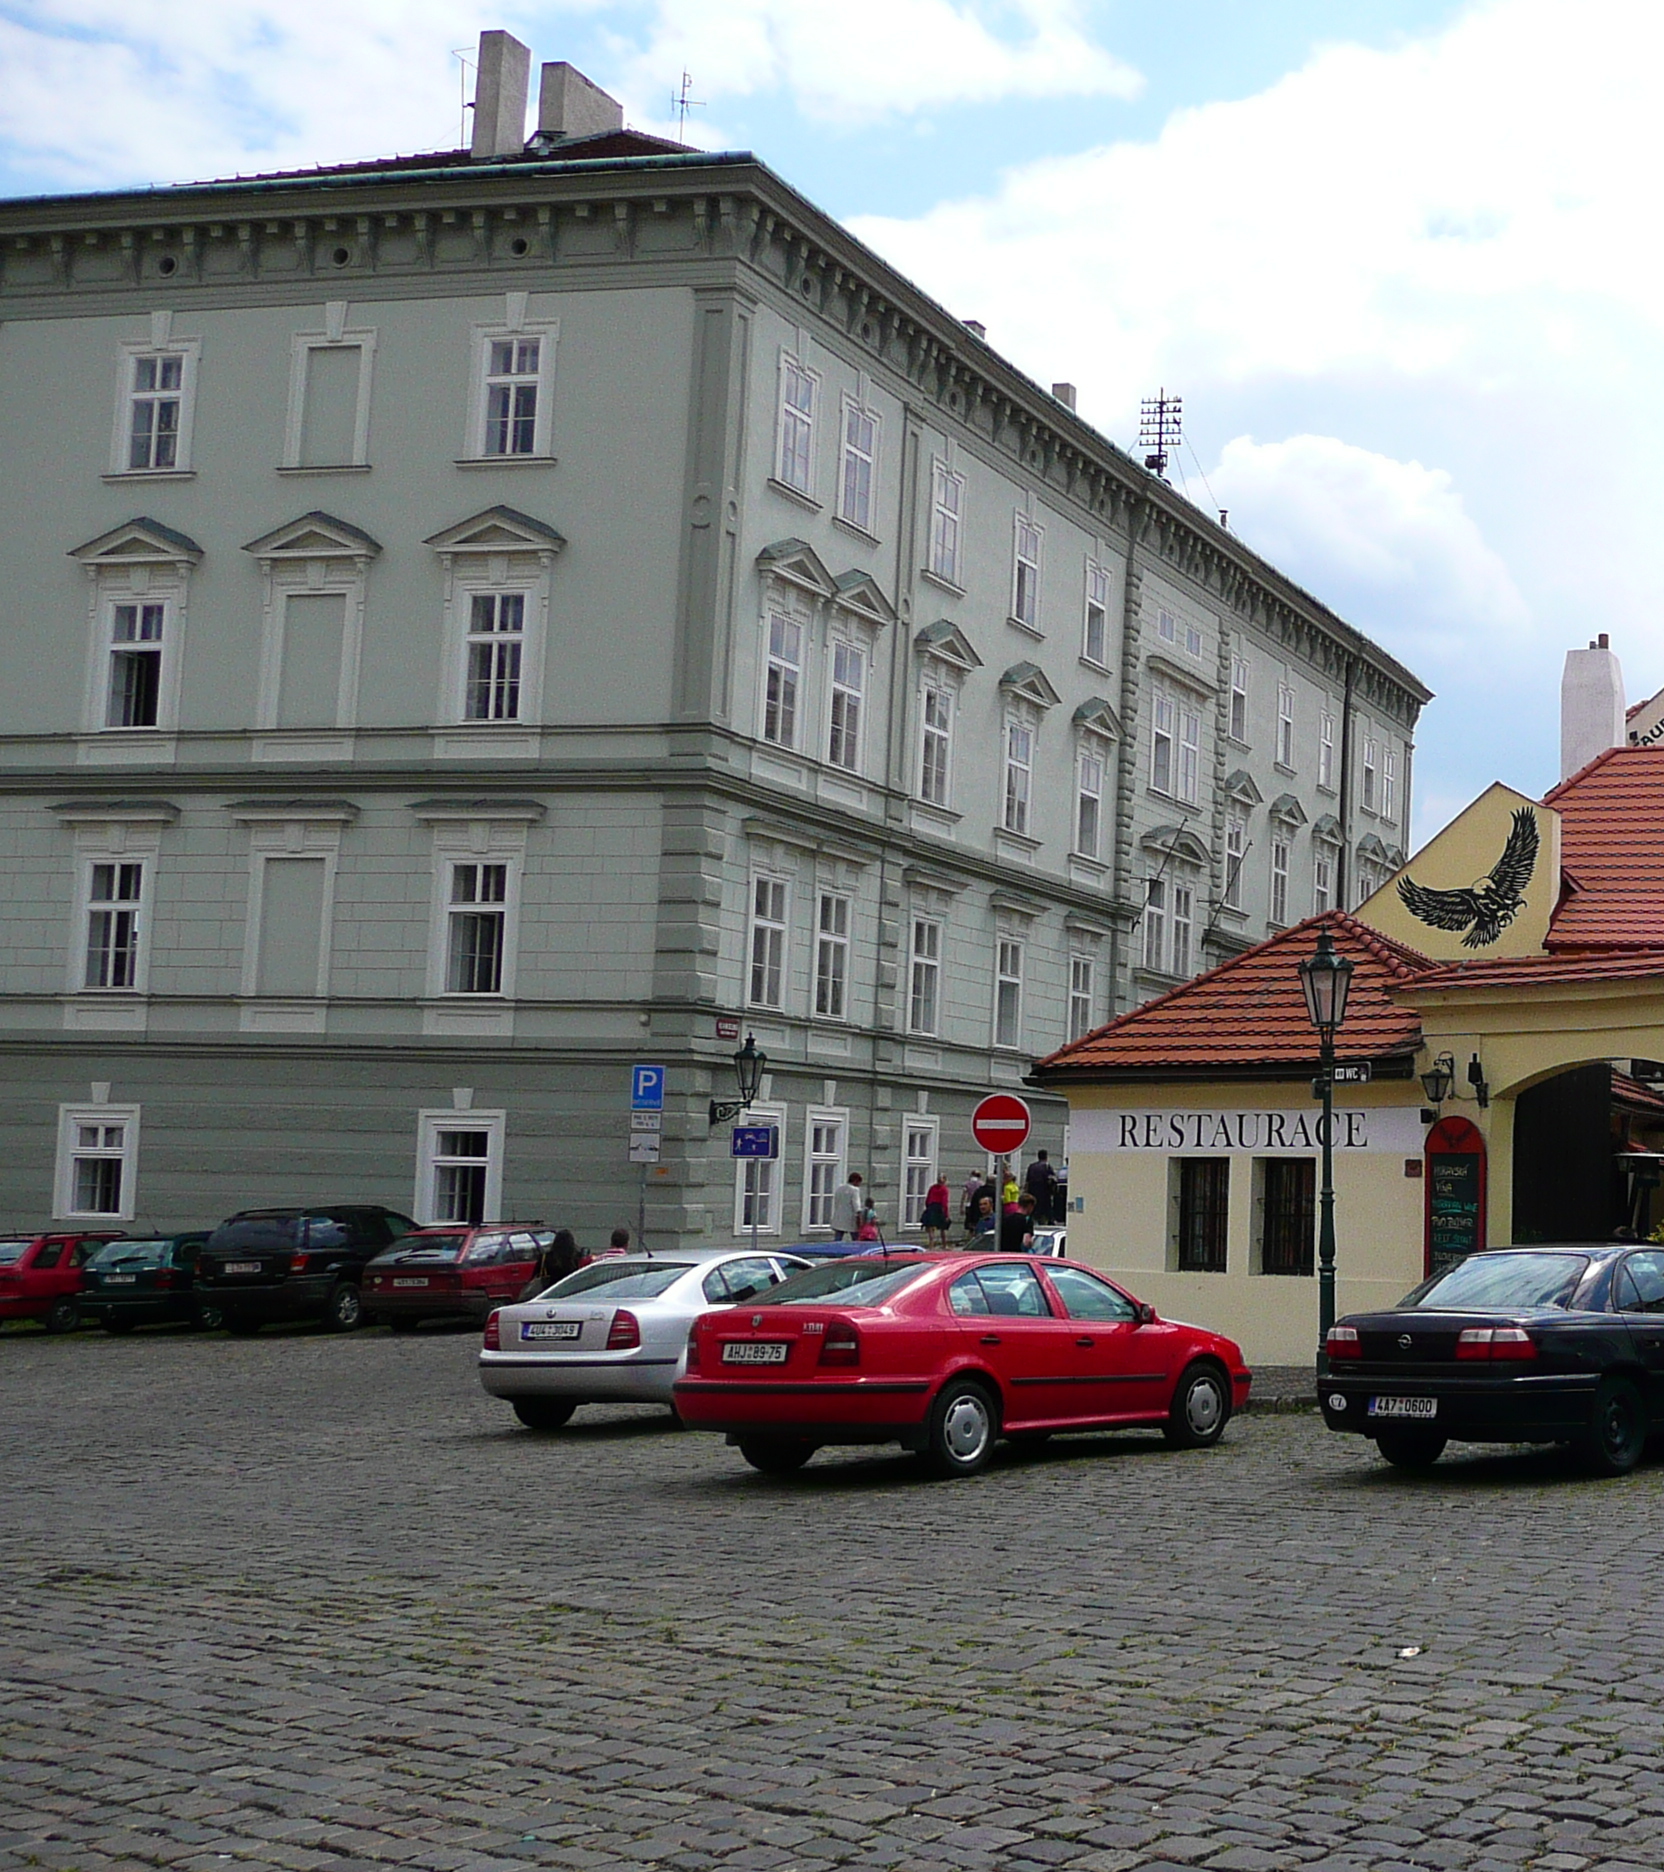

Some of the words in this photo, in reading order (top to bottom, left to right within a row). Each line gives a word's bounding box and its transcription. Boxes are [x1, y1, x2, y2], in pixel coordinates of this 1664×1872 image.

[1345, 1067, 1358, 1079] WC
[638, 1070, 657, 1096] P
[1117, 1112, 1369, 1149] RESTAURACE
[530, 1324, 546, 1336] 4U4
[553, 1324, 575, 1336] 3049
[727, 1345, 748, 1360] AHJ
[753, 1346, 782, 1360] 89-75
[1377, 1398, 1396, 1412] 4A7
[1405, 1399, 1433, 1413] 0600
